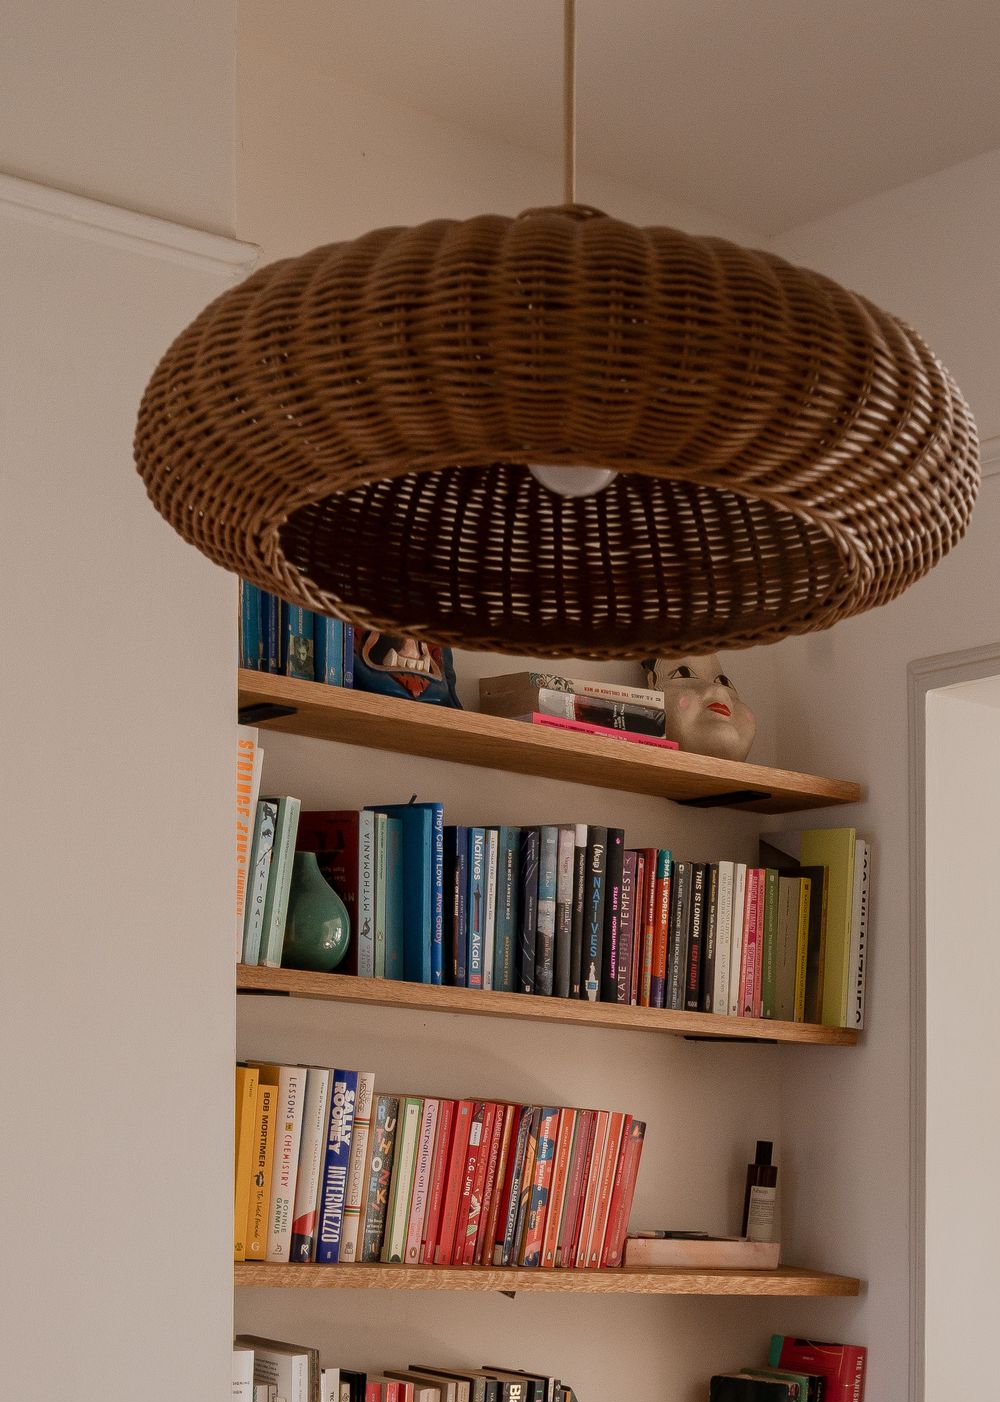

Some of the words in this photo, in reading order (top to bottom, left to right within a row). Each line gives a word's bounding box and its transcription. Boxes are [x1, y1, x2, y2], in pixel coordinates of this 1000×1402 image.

[435, 809, 443, 831] They
[473, 834, 483, 880] Natives
[592, 844, 604, 873] (Akala)
[255, 858, 266, 928] IKIGAI
[621, 868, 631, 926] TEMPEST
[695, 893, 701, 901] IS
[589, 876, 601, 957] NATIVES
[471, 933, 480, 969] Akala
[618, 966, 626, 1001] KATE
[673, 965, 679, 973] OF
[262, 1092, 270, 1112] BOB
[286, 1077, 297, 1119] LESSONS
[329, 1082, 347, 1154] ROONEY
[342, 1090, 355, 1146] SALLY
[494, 1110, 503, 1142] GABRIEL
[258, 1115, 269, 1167] MORTIMER
[419, 1104, 434, 1173] Conversations
[541, 1116, 552, 1159] Bernardine
[280, 1135, 292, 1188] CHEMISTRY
[467, 1157, 476, 1173] C.G.
[536, 1160, 546, 1191] Evaristo
[351, 1171, 361, 1206] COATES
[419, 1176, 426, 1187] on
[464, 1177, 473, 1196] Jung
[510, 1179, 519, 1212] NORMAL
[274, 1198, 282, 1234] GARMUS
[280, 1200, 289, 1233] BONNIE
[321, 1166, 346, 1242] INTERMEZZO
[415, 1189, 425, 1213] Love
[506, 1214, 514, 1241] PEOPLE
